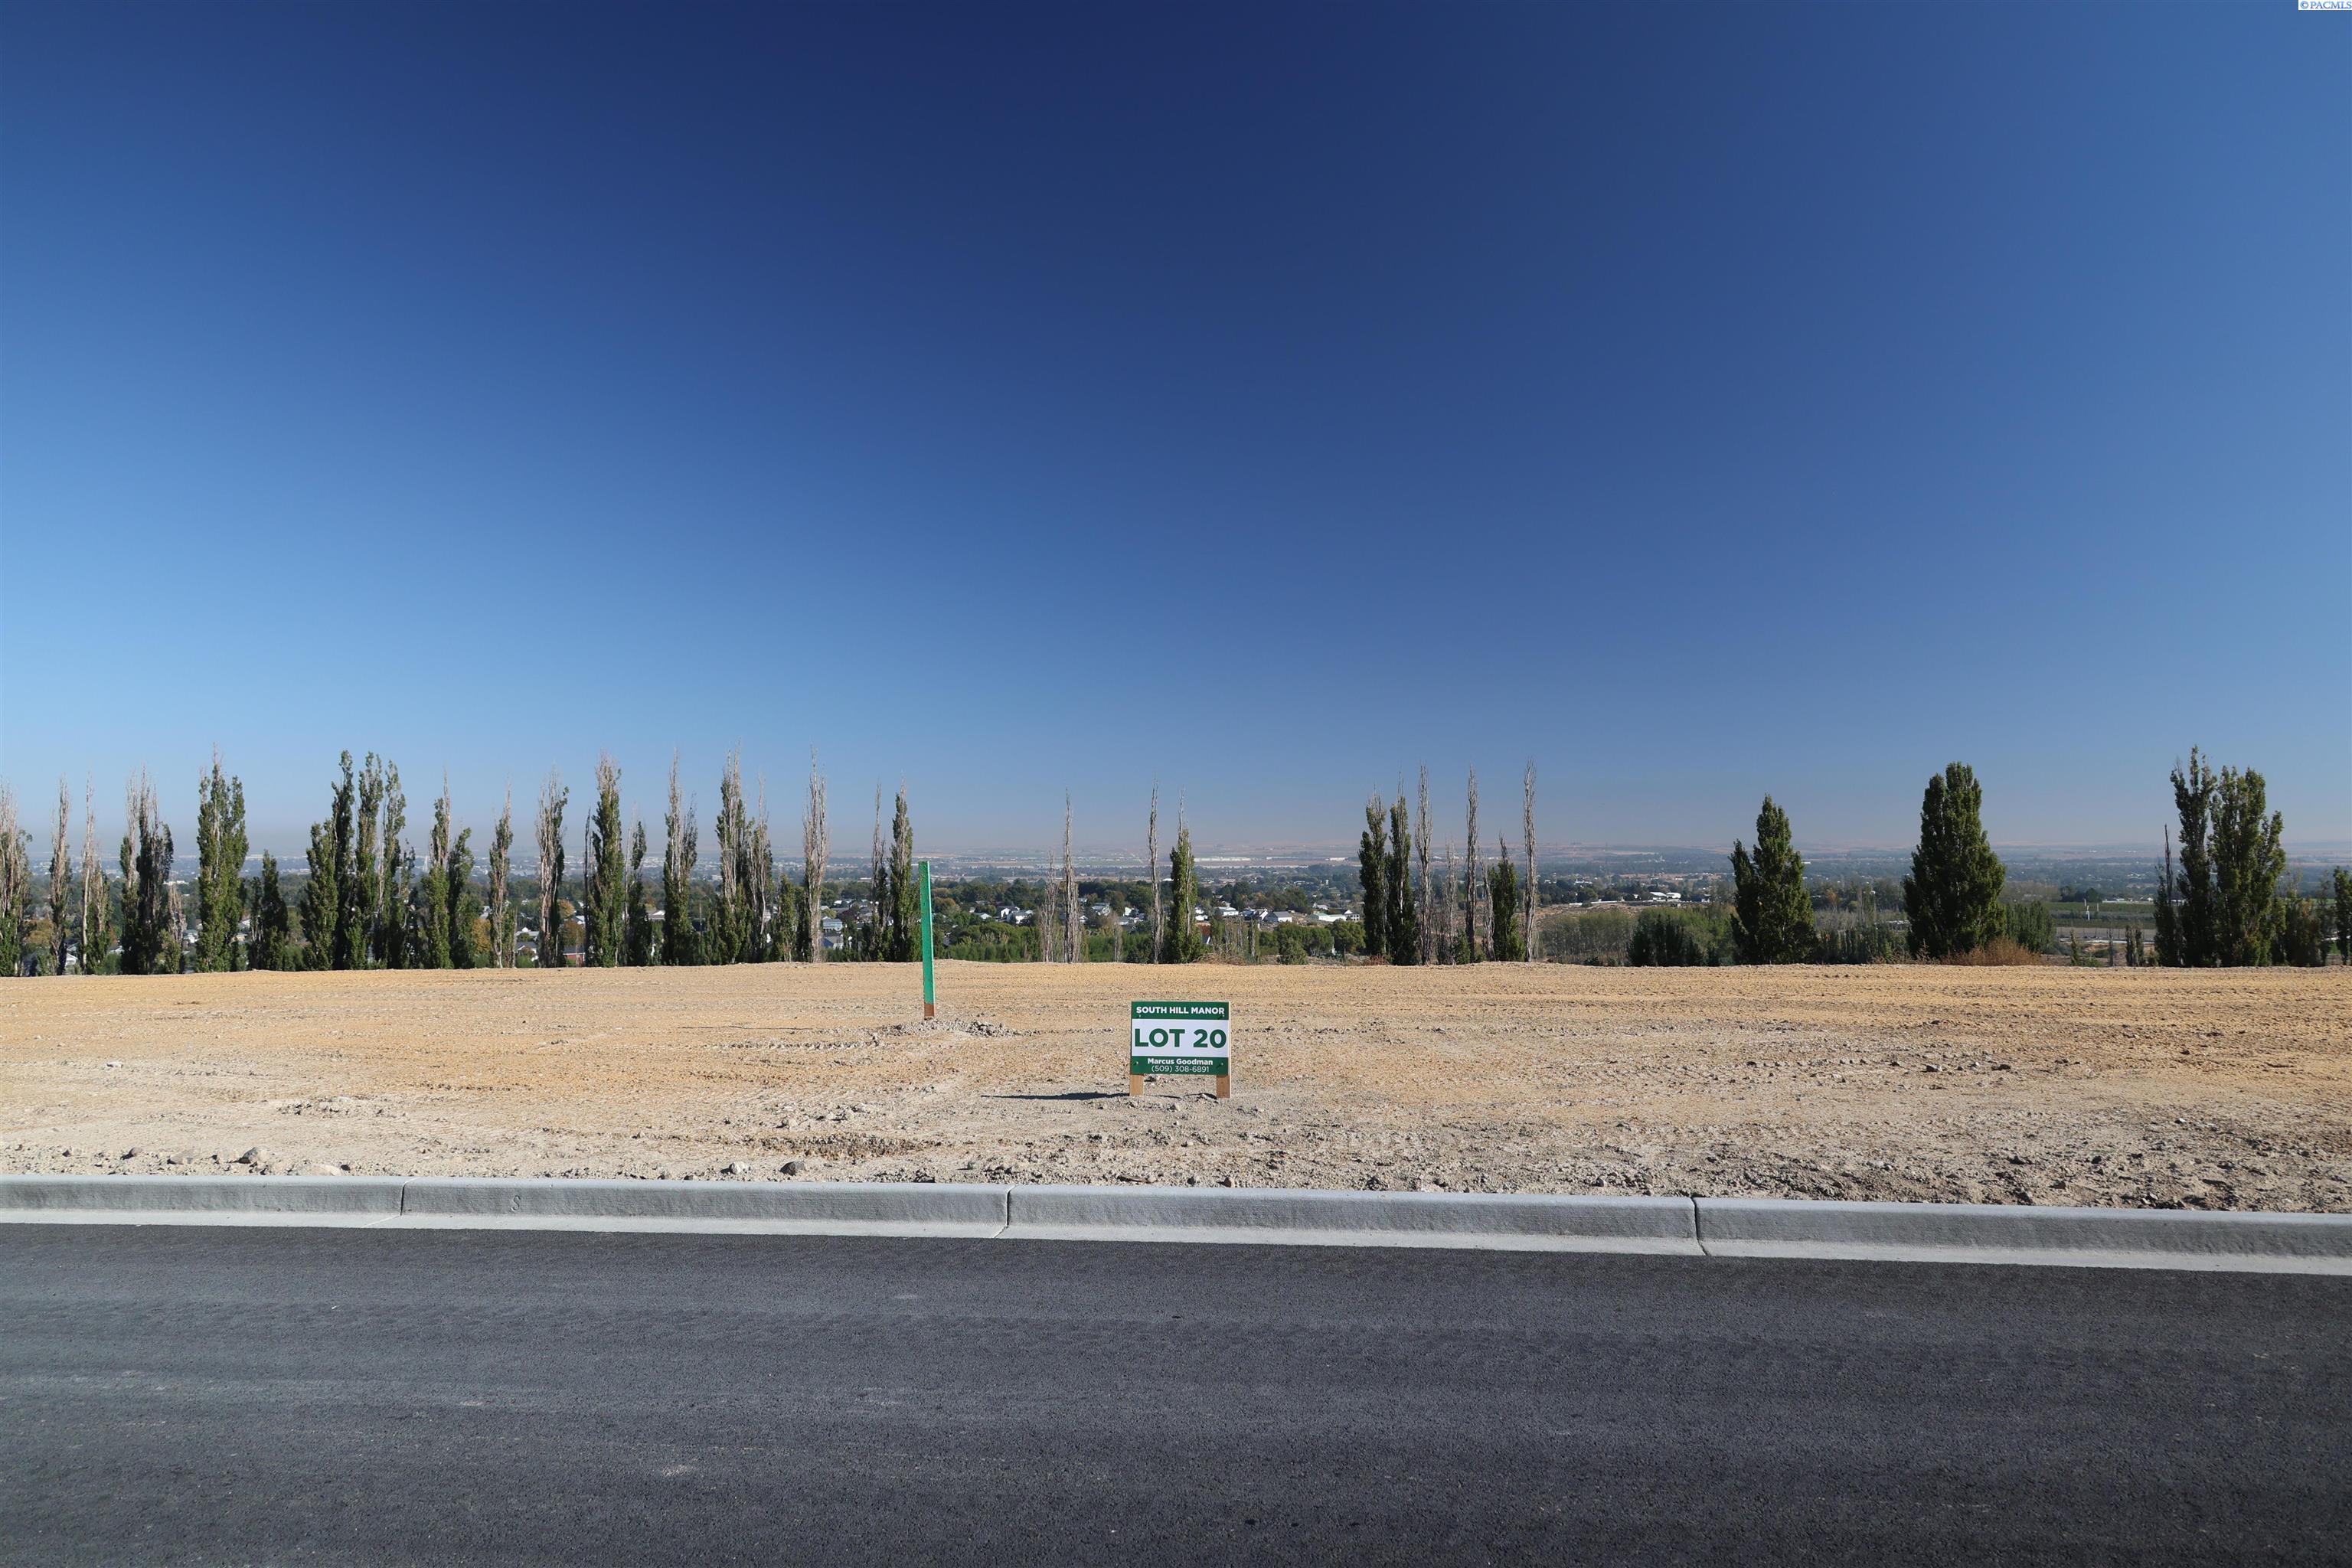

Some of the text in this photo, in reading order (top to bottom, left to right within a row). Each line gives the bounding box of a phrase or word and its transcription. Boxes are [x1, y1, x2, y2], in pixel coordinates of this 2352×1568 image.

[1135, 1028, 1227, 1048] LOT 20
[511, 1194, 521, 1211] S
